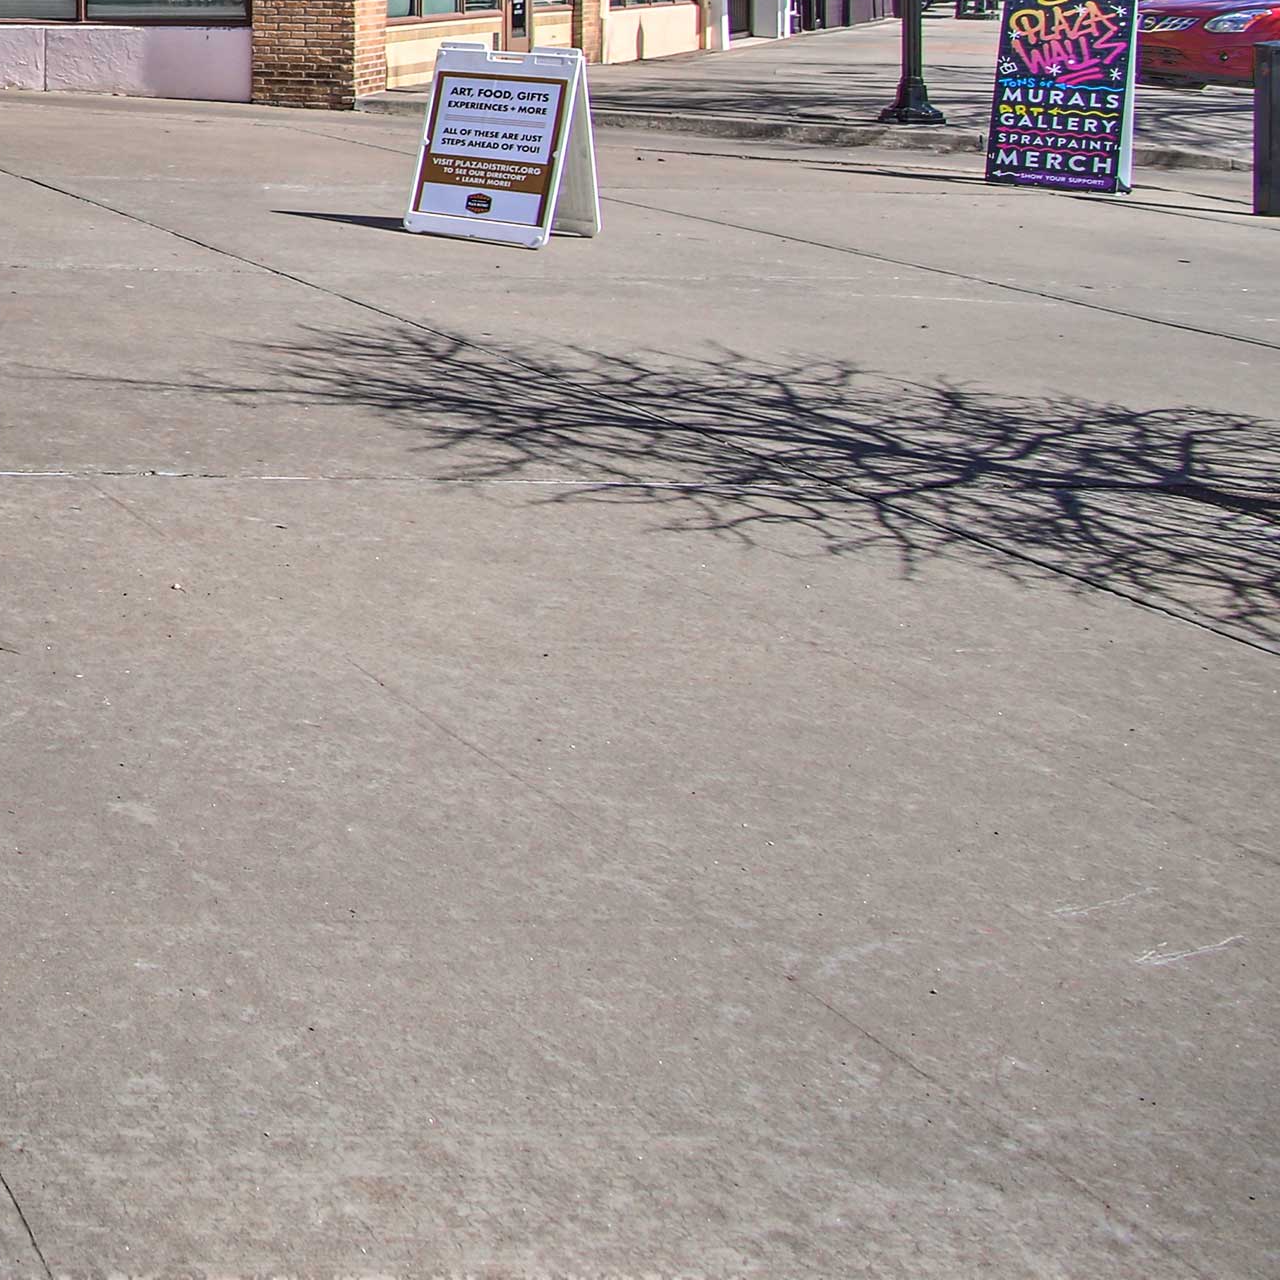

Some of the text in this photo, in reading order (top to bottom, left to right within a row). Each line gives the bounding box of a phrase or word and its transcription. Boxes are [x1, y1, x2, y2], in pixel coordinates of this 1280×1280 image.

[1009, 1, 1117, 44] PLAZA
[450, 86, 550, 103] ART, FOOD, GIFTS
[1002, 87, 1120, 108] MURALS
[447, 100, 509, 112] EXPERIENCES
[518, 105, 548, 115] MORE
[1000, 113, 1117, 134] GALLERY
[443, 127, 543, 143] ALL OF THESE ARE JUST
[998, 133, 1113, 152] SPRAYPAINT
[441, 137, 541, 154] STEPS AHEAD OF YOU!
[432, 157, 541, 176] VISIT PLAZADISTRICT.ORG
[996, 149, 1112, 174] MERCH
[461, 176, 486, 185] LEARN
[486, 178, 512, 188] MORE!
[468, 169, 486, 178] OUR
[486, 170, 527, 182] DIRECTORY
[1021, 172, 1105, 187] SHOW YOUR SUPPORT!
